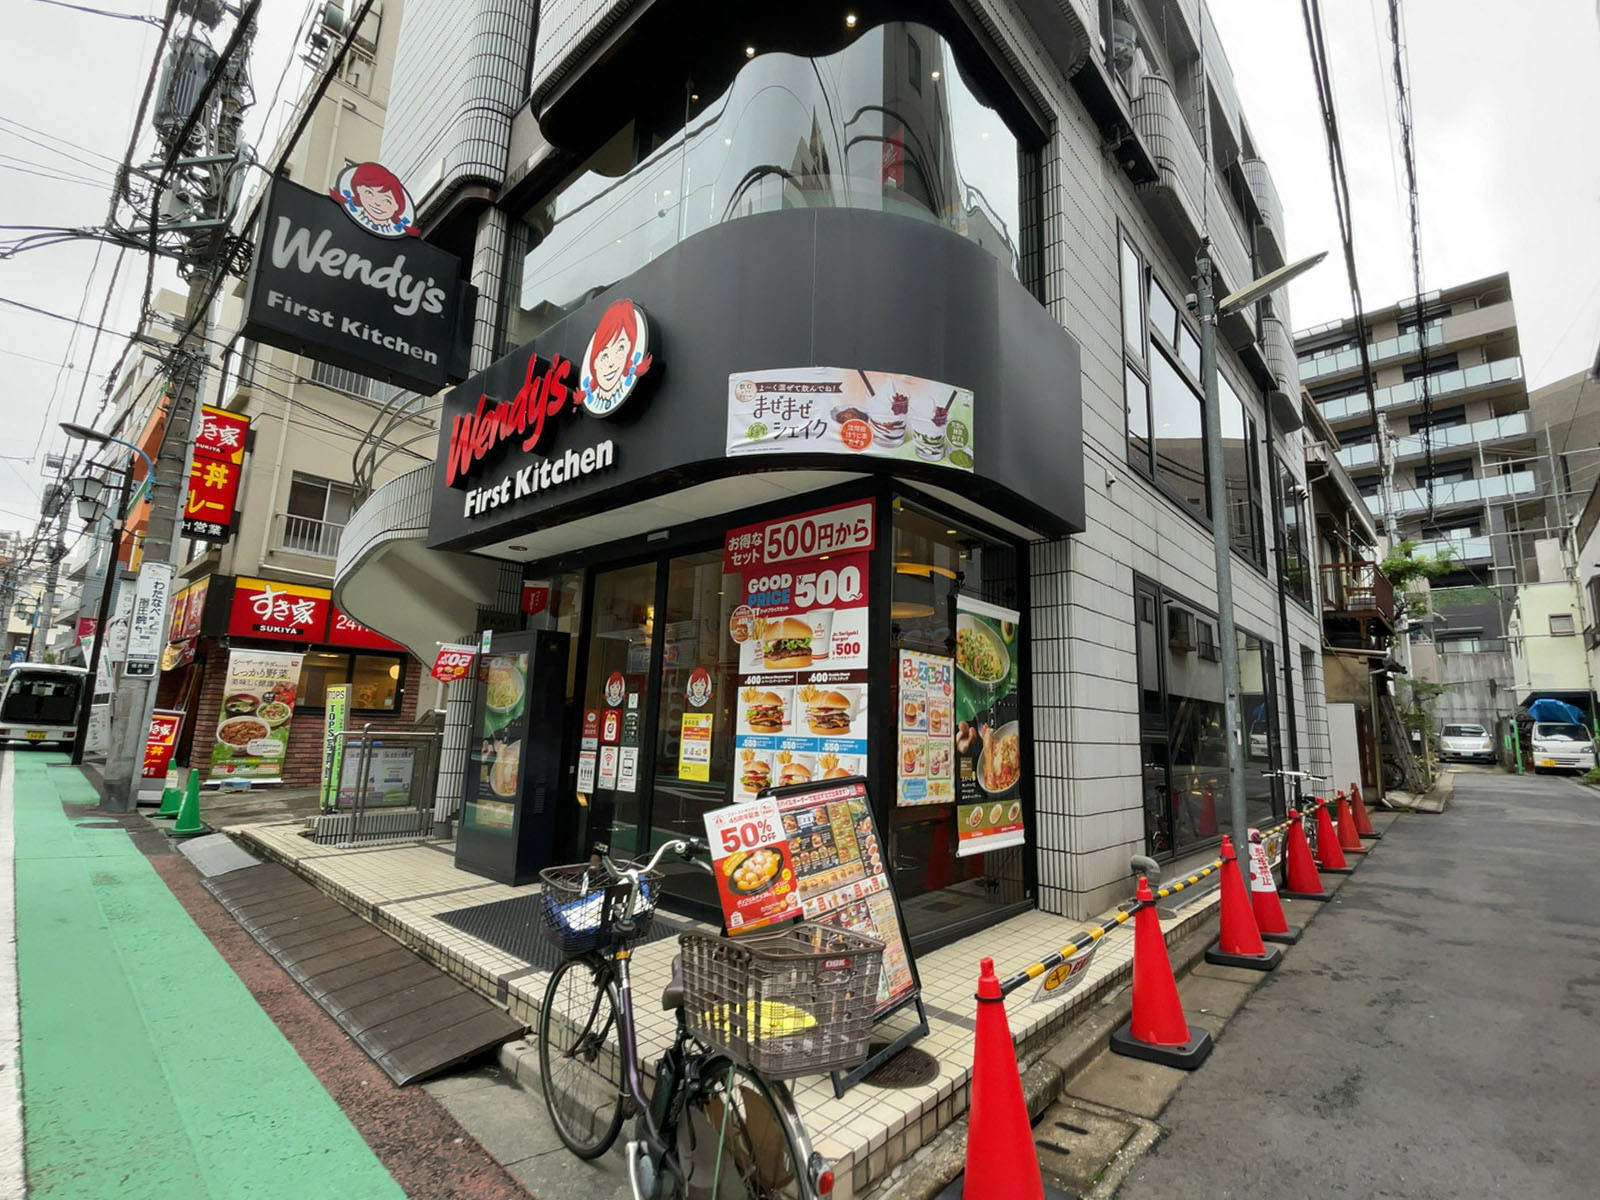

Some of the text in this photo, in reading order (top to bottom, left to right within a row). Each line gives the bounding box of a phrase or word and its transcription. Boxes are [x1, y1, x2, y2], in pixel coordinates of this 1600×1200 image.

[272, 216, 446, 316] Wendy's
[267, 290, 438, 365] First Kitchen
[446, 353, 571, 487] Wendy's
[753, 395, 813, 421] まぜまぜ
[773, 418, 828, 440] シェイク
[464, 439, 614, 518] First Kitchen
[728, 531, 763, 552] お得な
[767, 518, 869, 560] 500円から
[731, 548, 760, 566] セット
[747, 573, 793, 594] GOOD
[249, 584, 316, 627] すき家
[259, 624, 297, 635] SUKIYA
[720, 820, 773, 853] 50%
[760, 832, 777, 843] OFF
